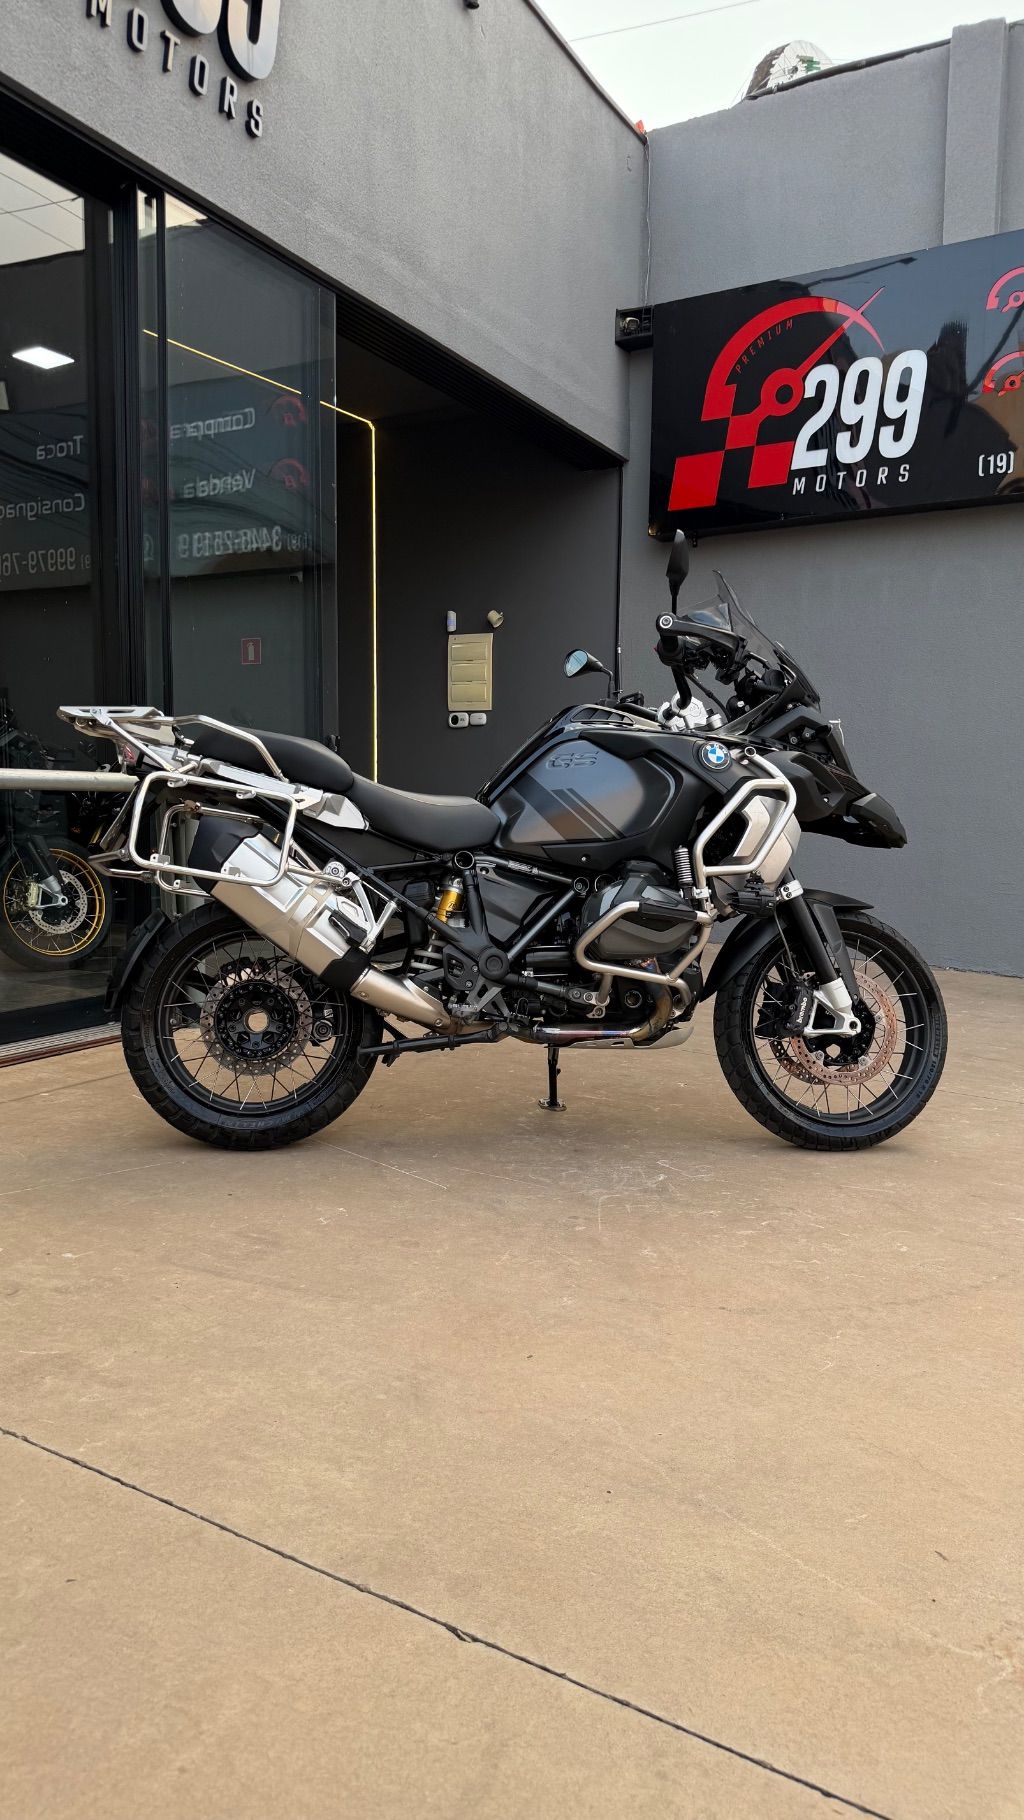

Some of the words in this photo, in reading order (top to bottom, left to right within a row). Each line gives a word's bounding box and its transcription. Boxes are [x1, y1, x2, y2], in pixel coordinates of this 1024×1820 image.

[735, 318, 793, 375] PREMIUM
[791, 349, 928, 470] 299
[978, 450, 1015, 477] (19)
[792, 464, 910, 496] MOTORS
[545, 750, 599, 770] GS
[796, 996, 808, 1024] brembo
